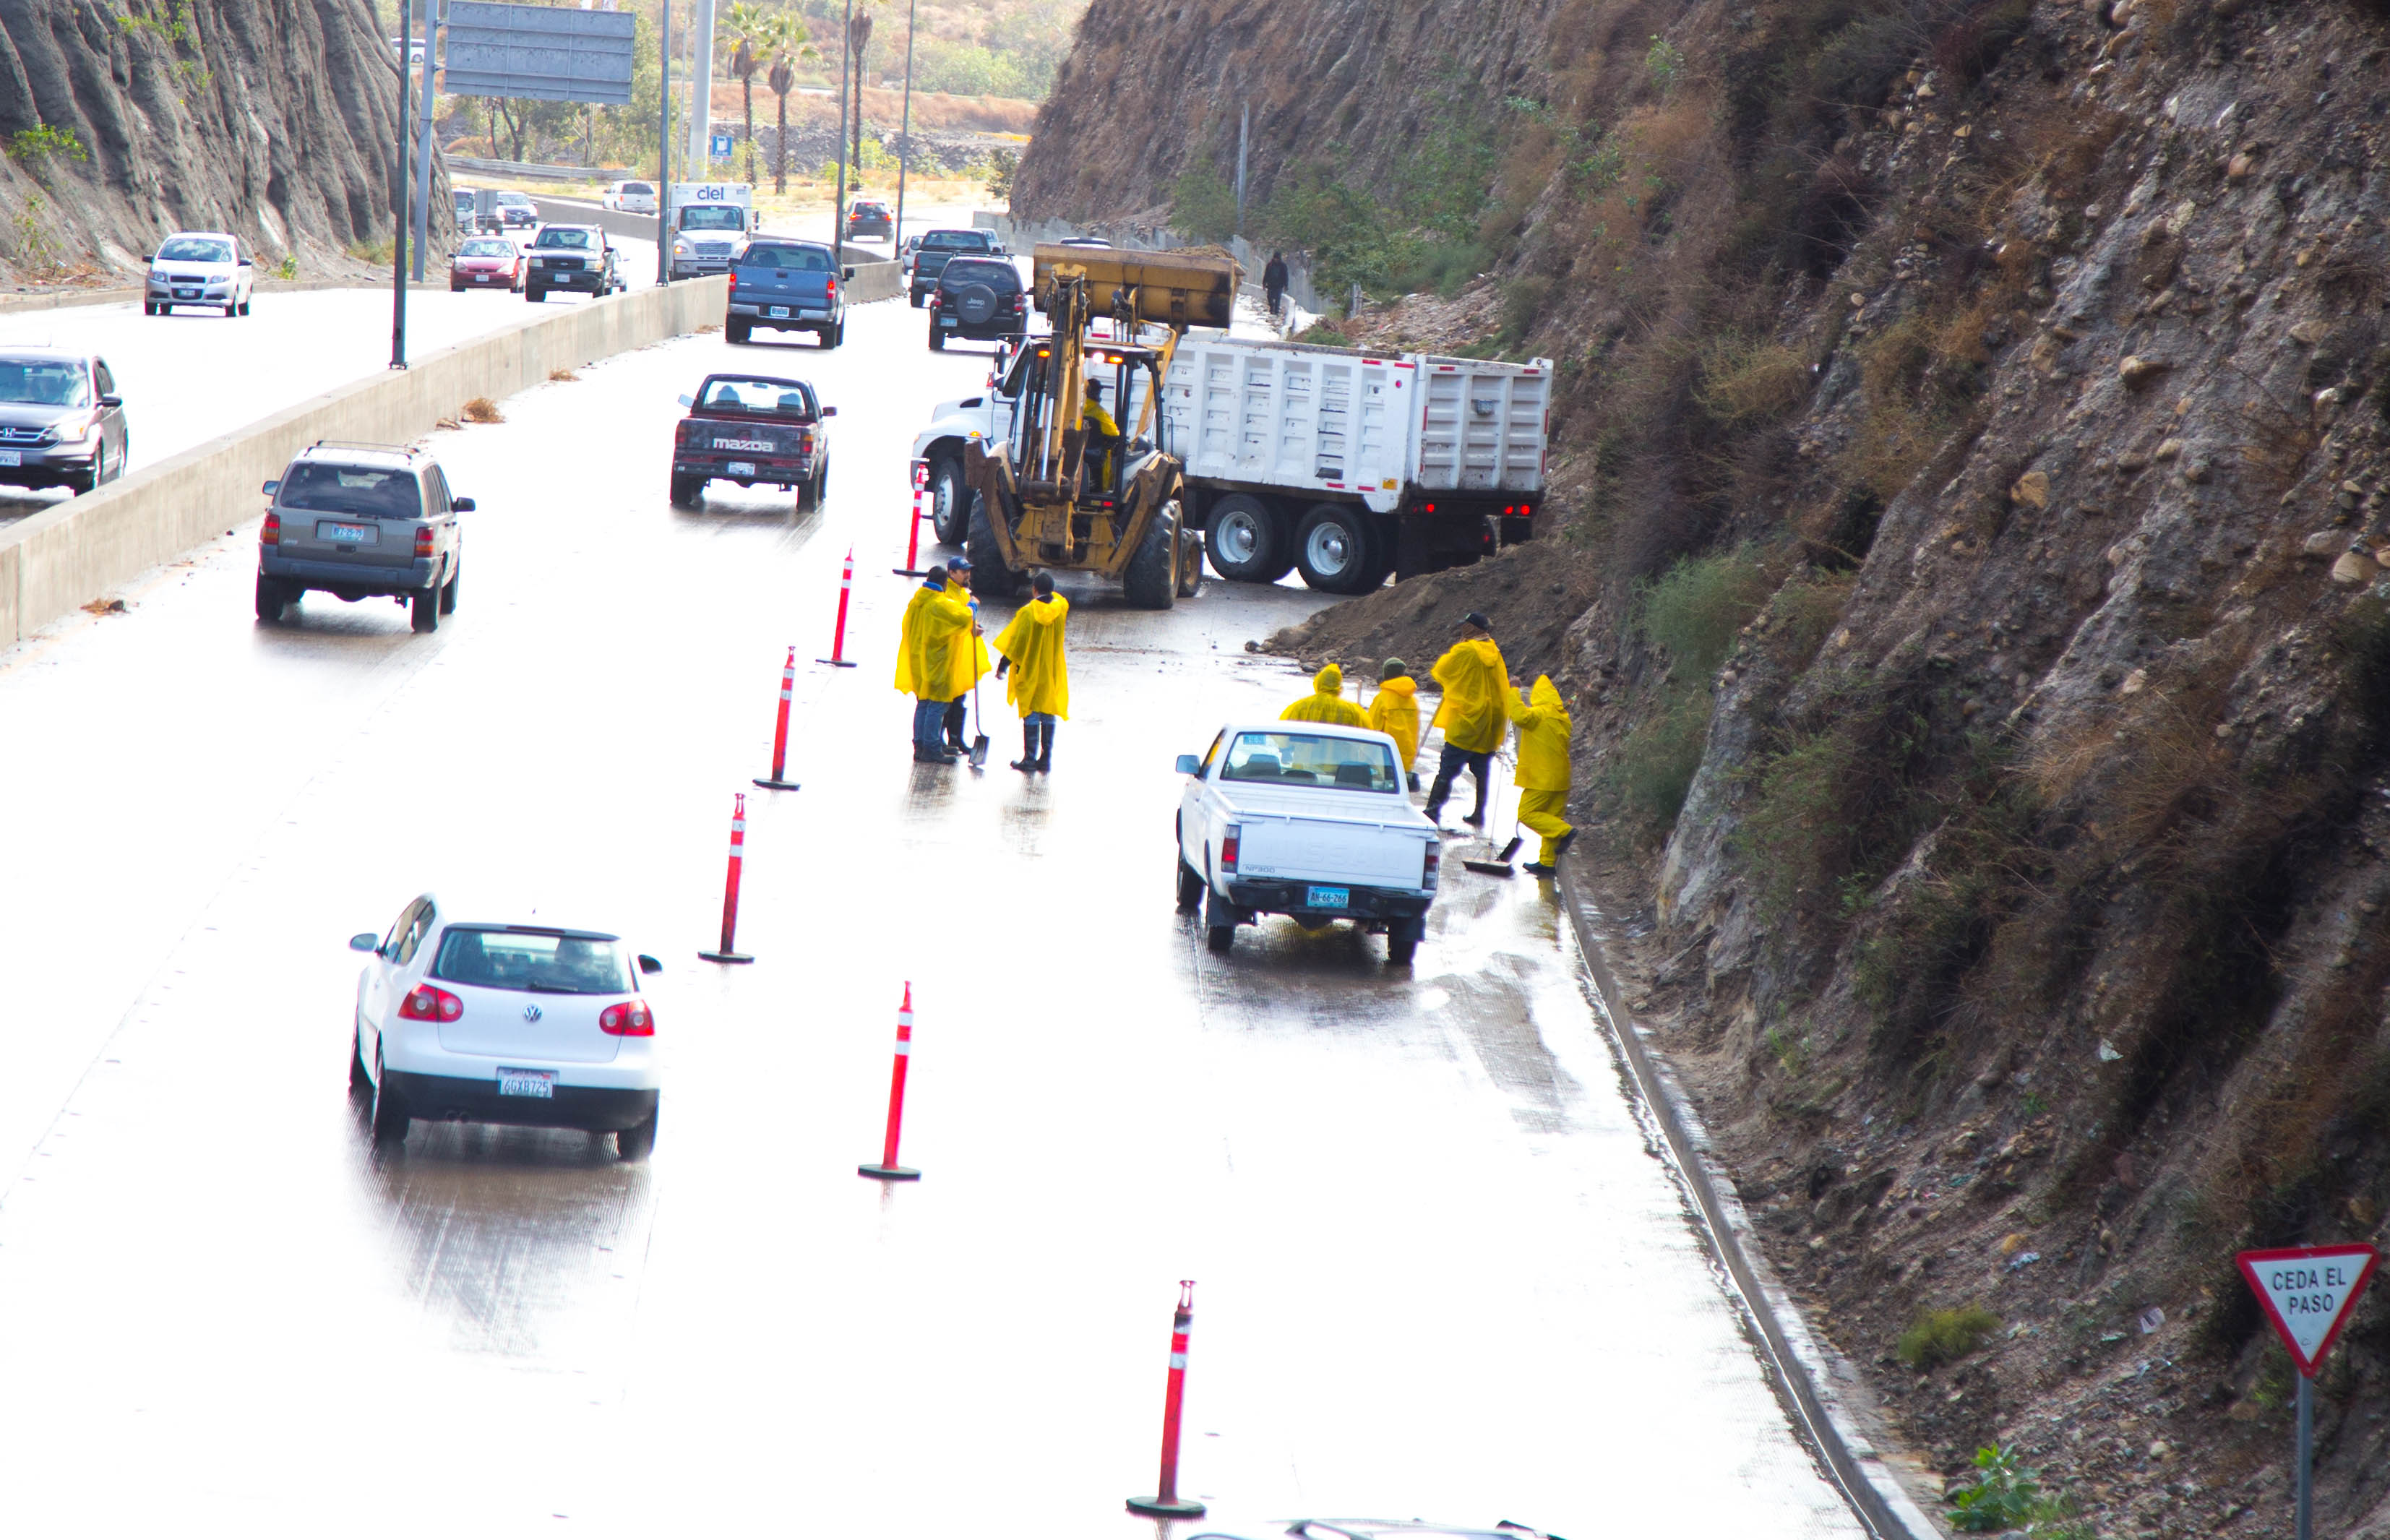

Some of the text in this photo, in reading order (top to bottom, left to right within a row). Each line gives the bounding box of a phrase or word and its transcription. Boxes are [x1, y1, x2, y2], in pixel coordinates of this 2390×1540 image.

[697, 185, 724, 199] ciel
[713, 438, 775, 452] mazda
[504, 1080, 549, 1093] 6GXB725
[2272, 1267, 2347, 1291] CEDA EL
[2289, 1293, 2334, 1315] PASO
